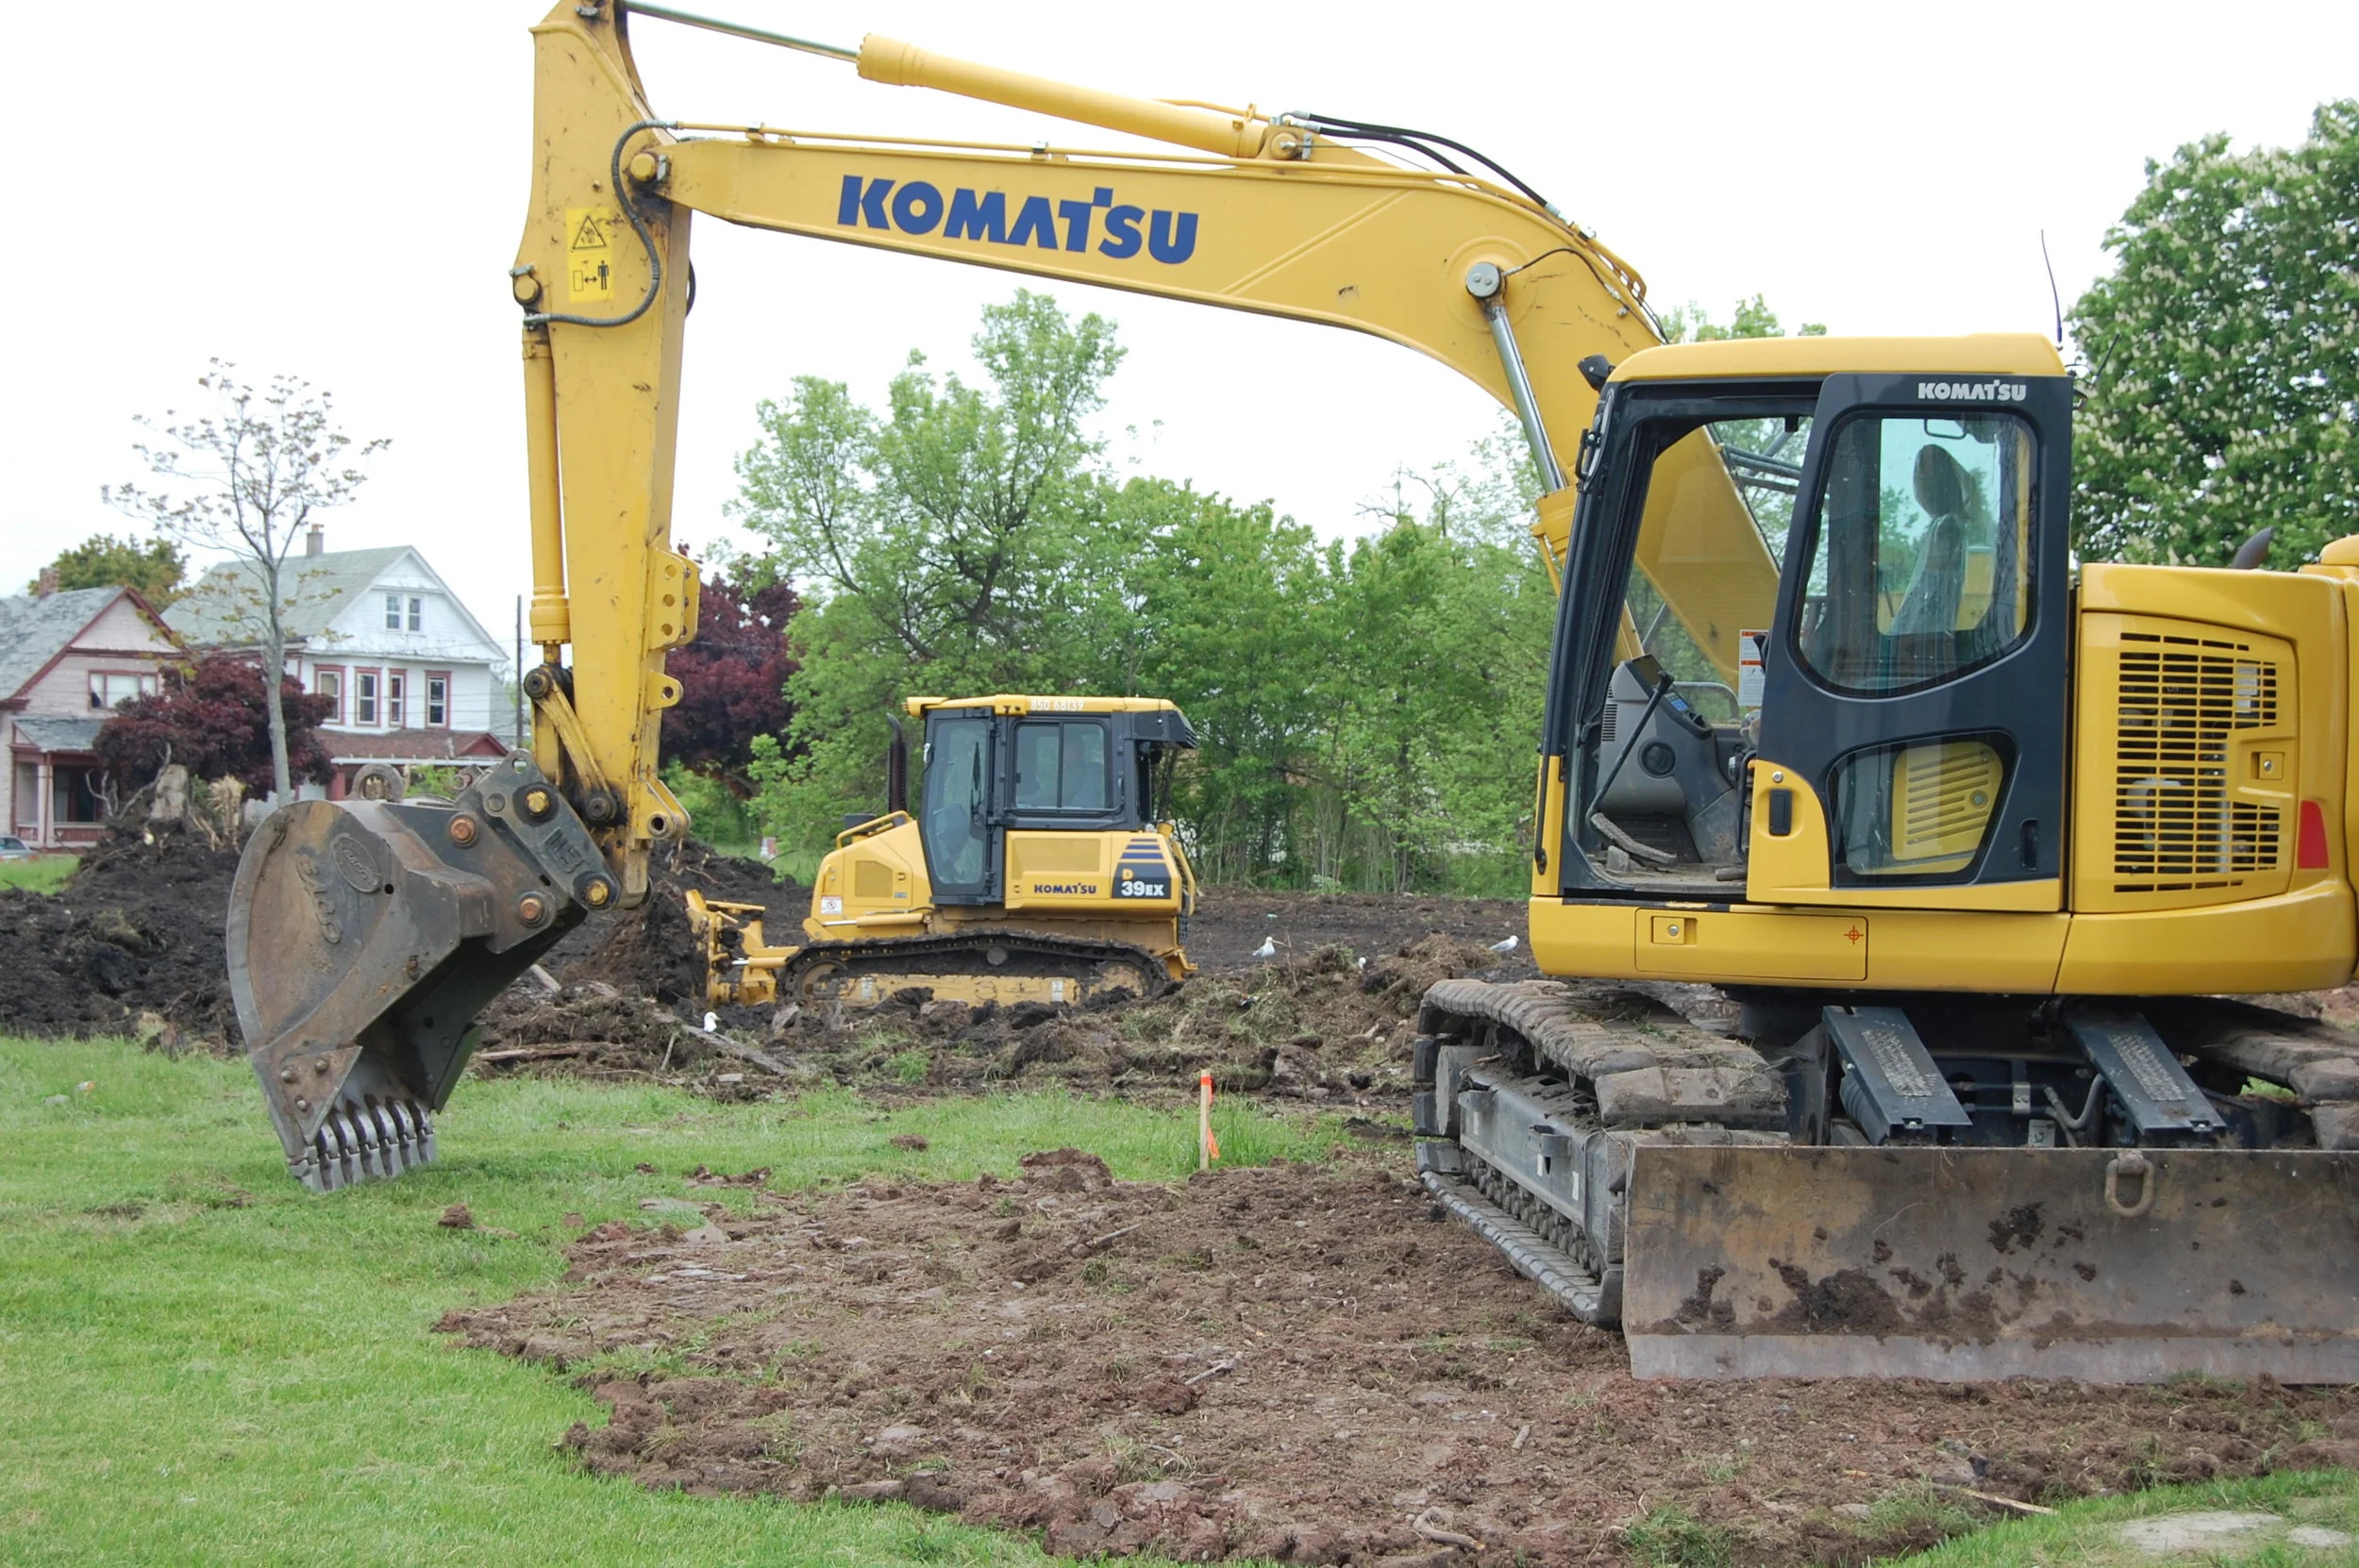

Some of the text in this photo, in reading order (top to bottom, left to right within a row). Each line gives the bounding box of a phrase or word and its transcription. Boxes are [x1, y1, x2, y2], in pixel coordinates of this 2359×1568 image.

[837, 175, 1198, 265] KOMATSU
[1917, 379, 2027, 401] KOMATSU
[1122, 869, 1134, 880] D
[1033, 882, 1096, 894] KOMATSU
[1121, 881, 1164, 897] 39EX
